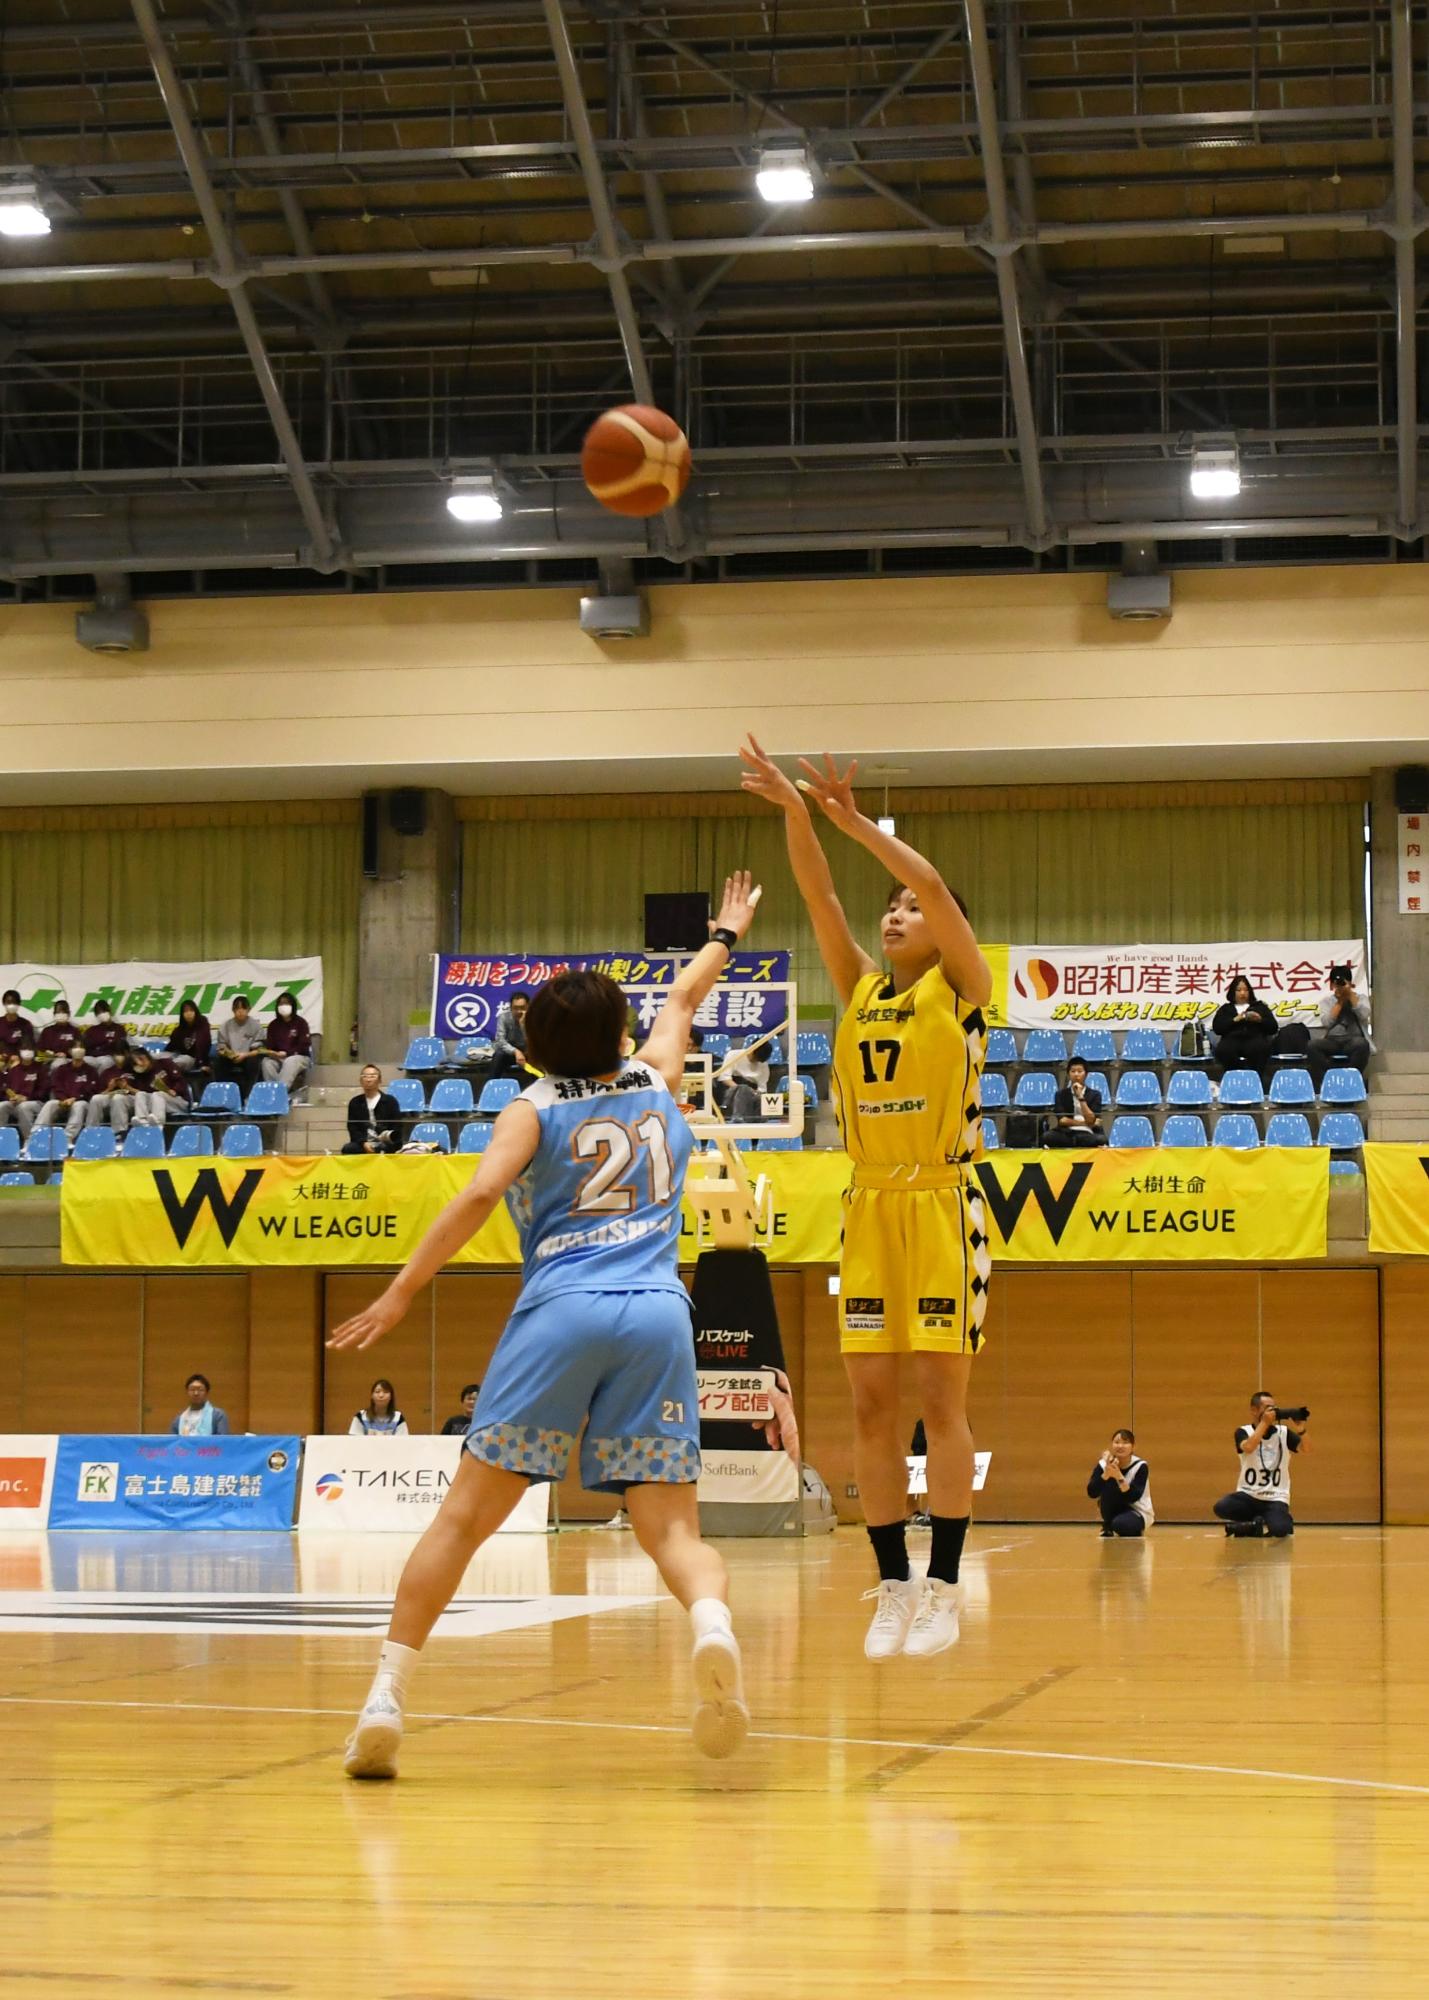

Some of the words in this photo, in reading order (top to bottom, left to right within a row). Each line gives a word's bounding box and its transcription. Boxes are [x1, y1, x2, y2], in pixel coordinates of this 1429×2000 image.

[1124, 954, 1147, 962] have
[1177, 954, 1208, 962] Hands
[859, 1040, 901, 1083] 17
[765, 1096, 779, 1106] W
[571, 1112, 675, 1215] 21
[292, 1182, 370, 1200] 大樹生命
[1123, 1175, 1206, 1194] 大樹生命
[152, 1168, 266, 1250] W
[974, 1161, 1093, 1246] W
[258, 1216, 287, 1237] W
[294, 1215, 397, 1238] LEAGUE
[1089, 1210, 1119, 1232] W
[1126, 1209, 1236, 1233] LEAGUE
[697, 1330, 754, 1342] バスケット
[716, 1346, 748, 1357] LIVE
[662, 1400, 684, 1422] 21
[704, 1463, 759, 1476] SoftBank
[1245, 1467, 1281, 1487] 030
[124, 1474, 238, 1497] 富士島建設
